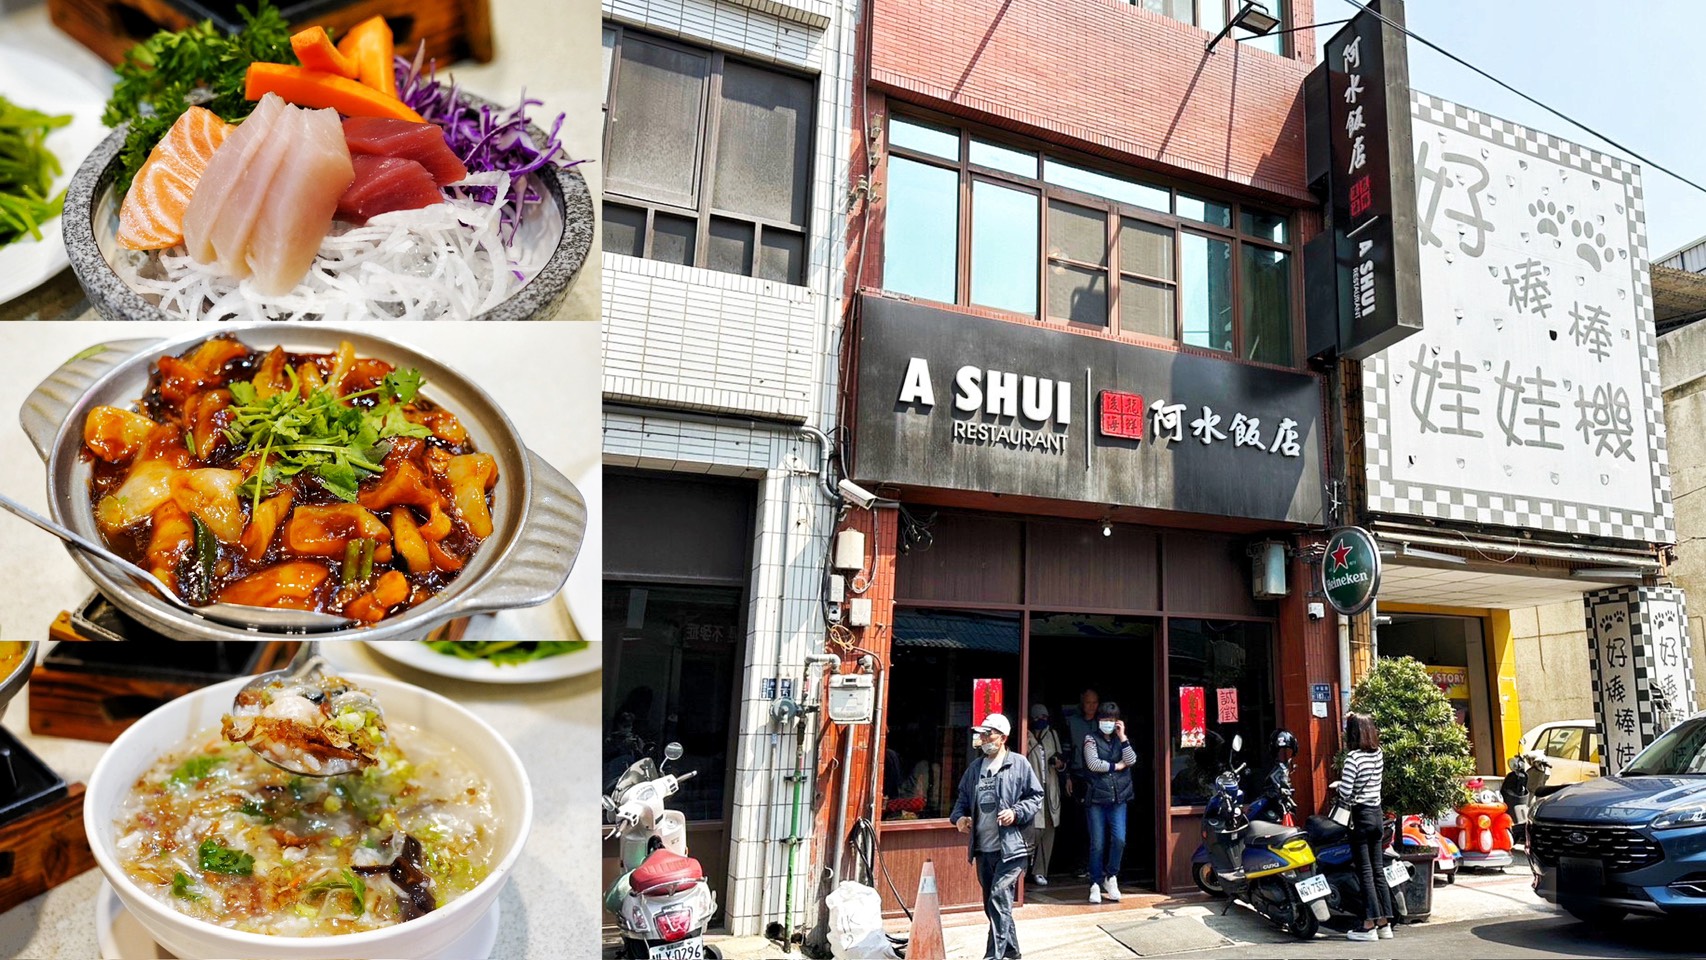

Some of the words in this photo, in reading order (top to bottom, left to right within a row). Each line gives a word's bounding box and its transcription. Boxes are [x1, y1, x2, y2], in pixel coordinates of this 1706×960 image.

[1342, 36, 1367, 174] 阿水飯店
[1359, 239, 1374, 257] A
[1360, 260, 1376, 317] SHUI
[899, 357, 935, 406] A
[955, 365, 1071, 425] SHUI
[1409, 342, 1636, 462] 娃娃機
[953, 420, 1069, 451] RESTAURANT
[1150, 398, 1302, 458] 阿水飯店
[1326, 571, 1369, 591] Heineken
[1436, 673, 1465, 684] STORY
[978, 784, 996, 792] adida
